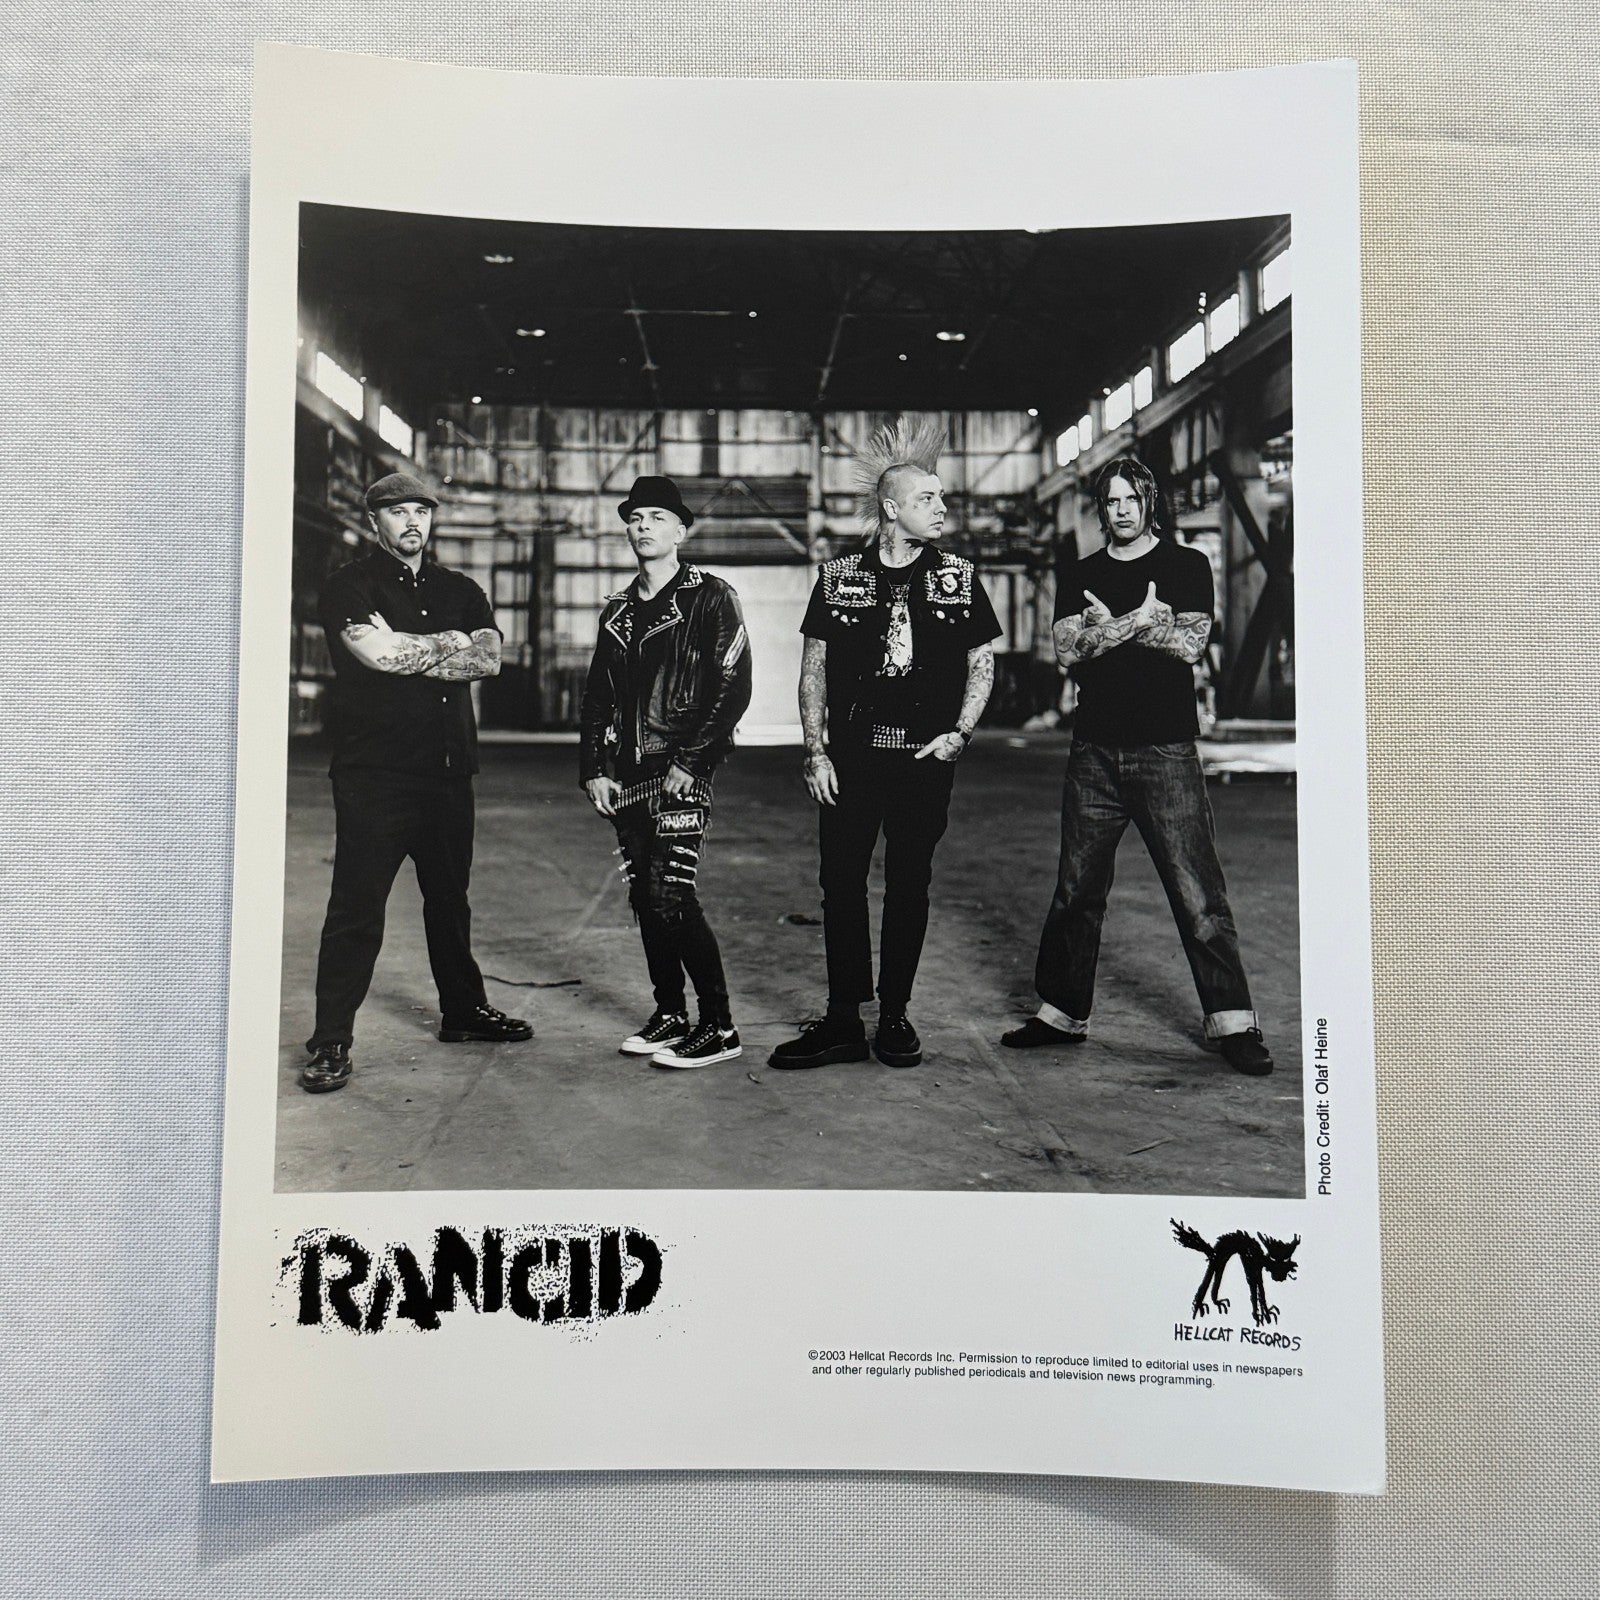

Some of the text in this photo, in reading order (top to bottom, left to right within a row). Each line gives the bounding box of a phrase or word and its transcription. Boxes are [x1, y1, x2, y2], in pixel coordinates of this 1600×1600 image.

[1314, 1018, 1332, 1196] Photo Credit: Olaf Heine
[292, 1225, 664, 1335] RANCID
[1175, 1323, 1301, 1351] HELLCAT RECORDS
[811, 1364, 1215, 1389] and other regularly published periodicals and television news programming.
[849, 1350, 886, 1362] Hellcat
[888, 1350, 933, 1362] Records
[936, 1351, 955, 1363] Inc.
[959, 1352, 1018, 1364] Permission
[1021, 1354, 1032, 1365] to
[1035, 1355, 1090, 1367] reproduce
[1092, 1356, 1129, 1368] limited
[1131, 1358, 1143, 1369] to
[1145, 1358, 1189, 1371] editorial
[1192, 1362, 1219, 1372] uses
[1222, 1361, 1233, 1373] in
[1235, 1364, 1303, 1378] newspapers
